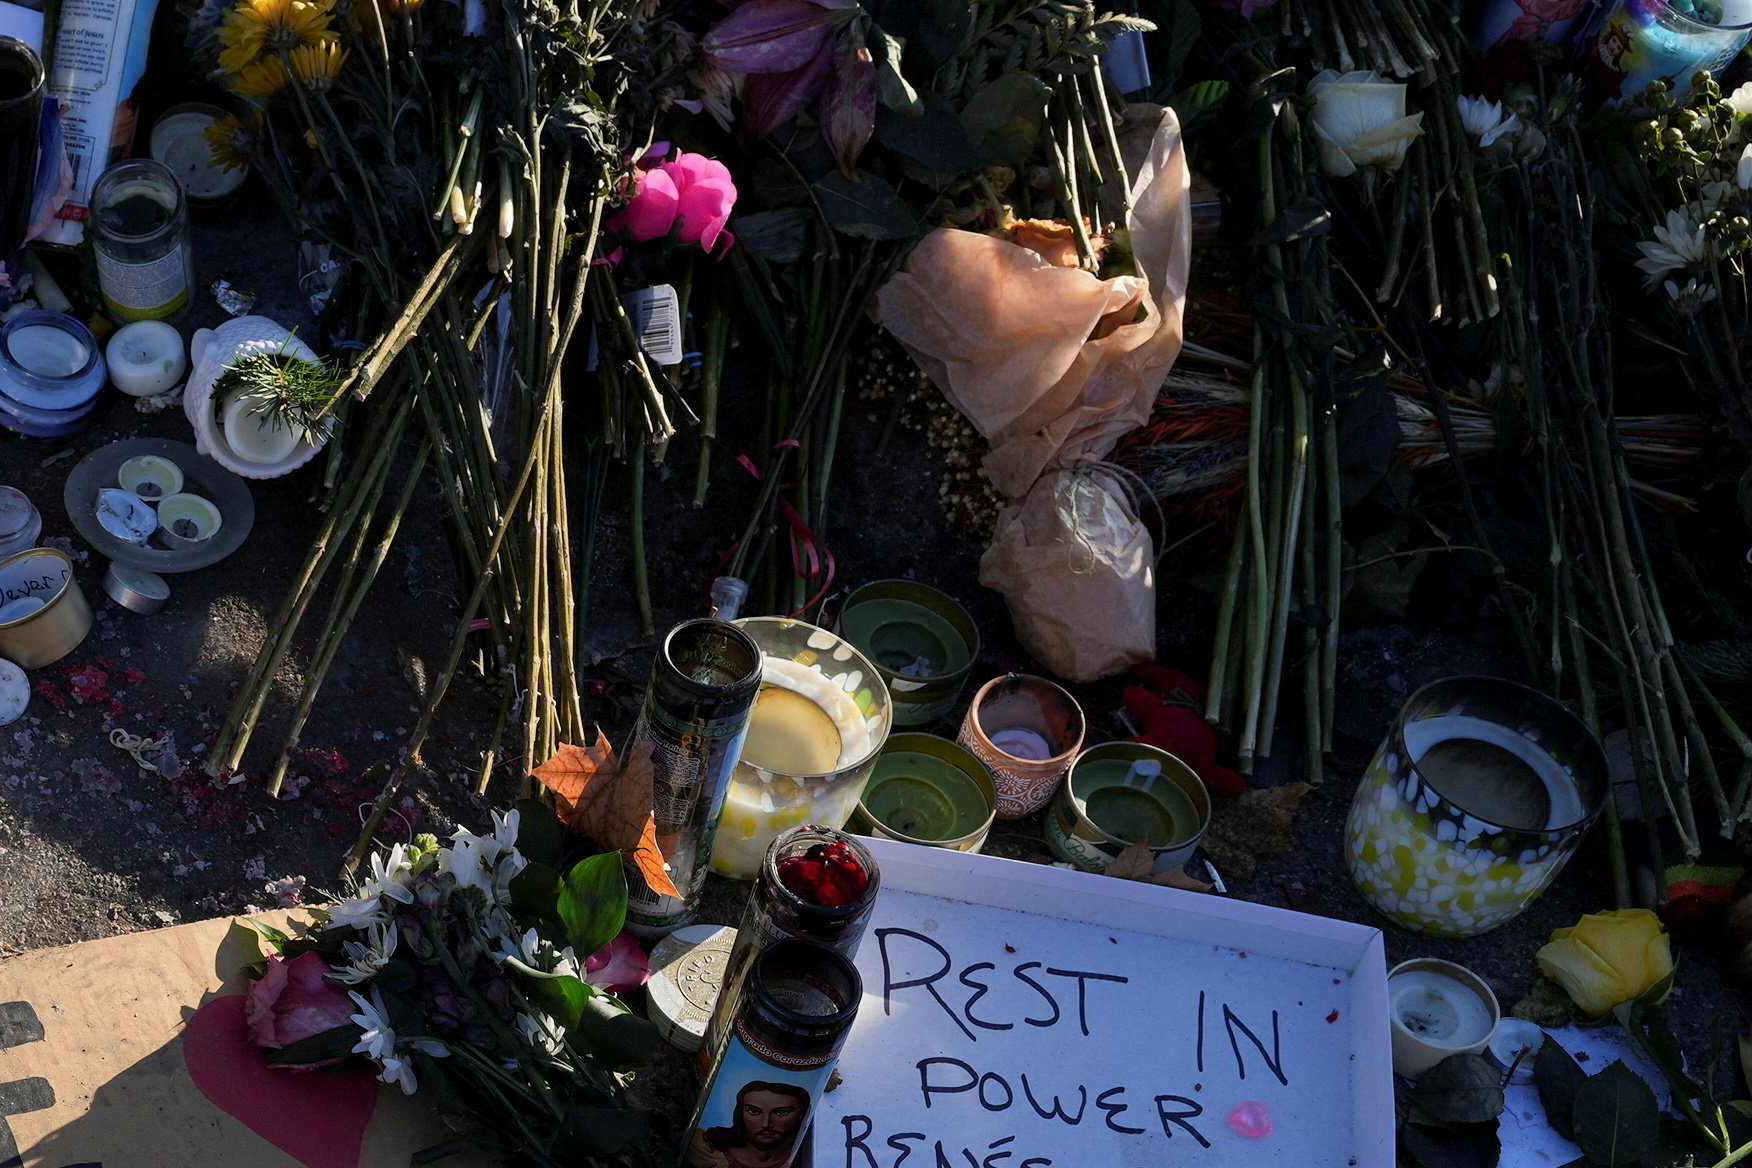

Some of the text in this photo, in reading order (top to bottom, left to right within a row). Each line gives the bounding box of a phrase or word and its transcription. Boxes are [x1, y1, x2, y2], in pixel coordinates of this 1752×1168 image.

[84, 29, 105, 40] Jesus
[875, 927, 1129, 1042] REST
[1196, 990, 1289, 1086] IN
[915, 1057, 1211, 1148] POWER
